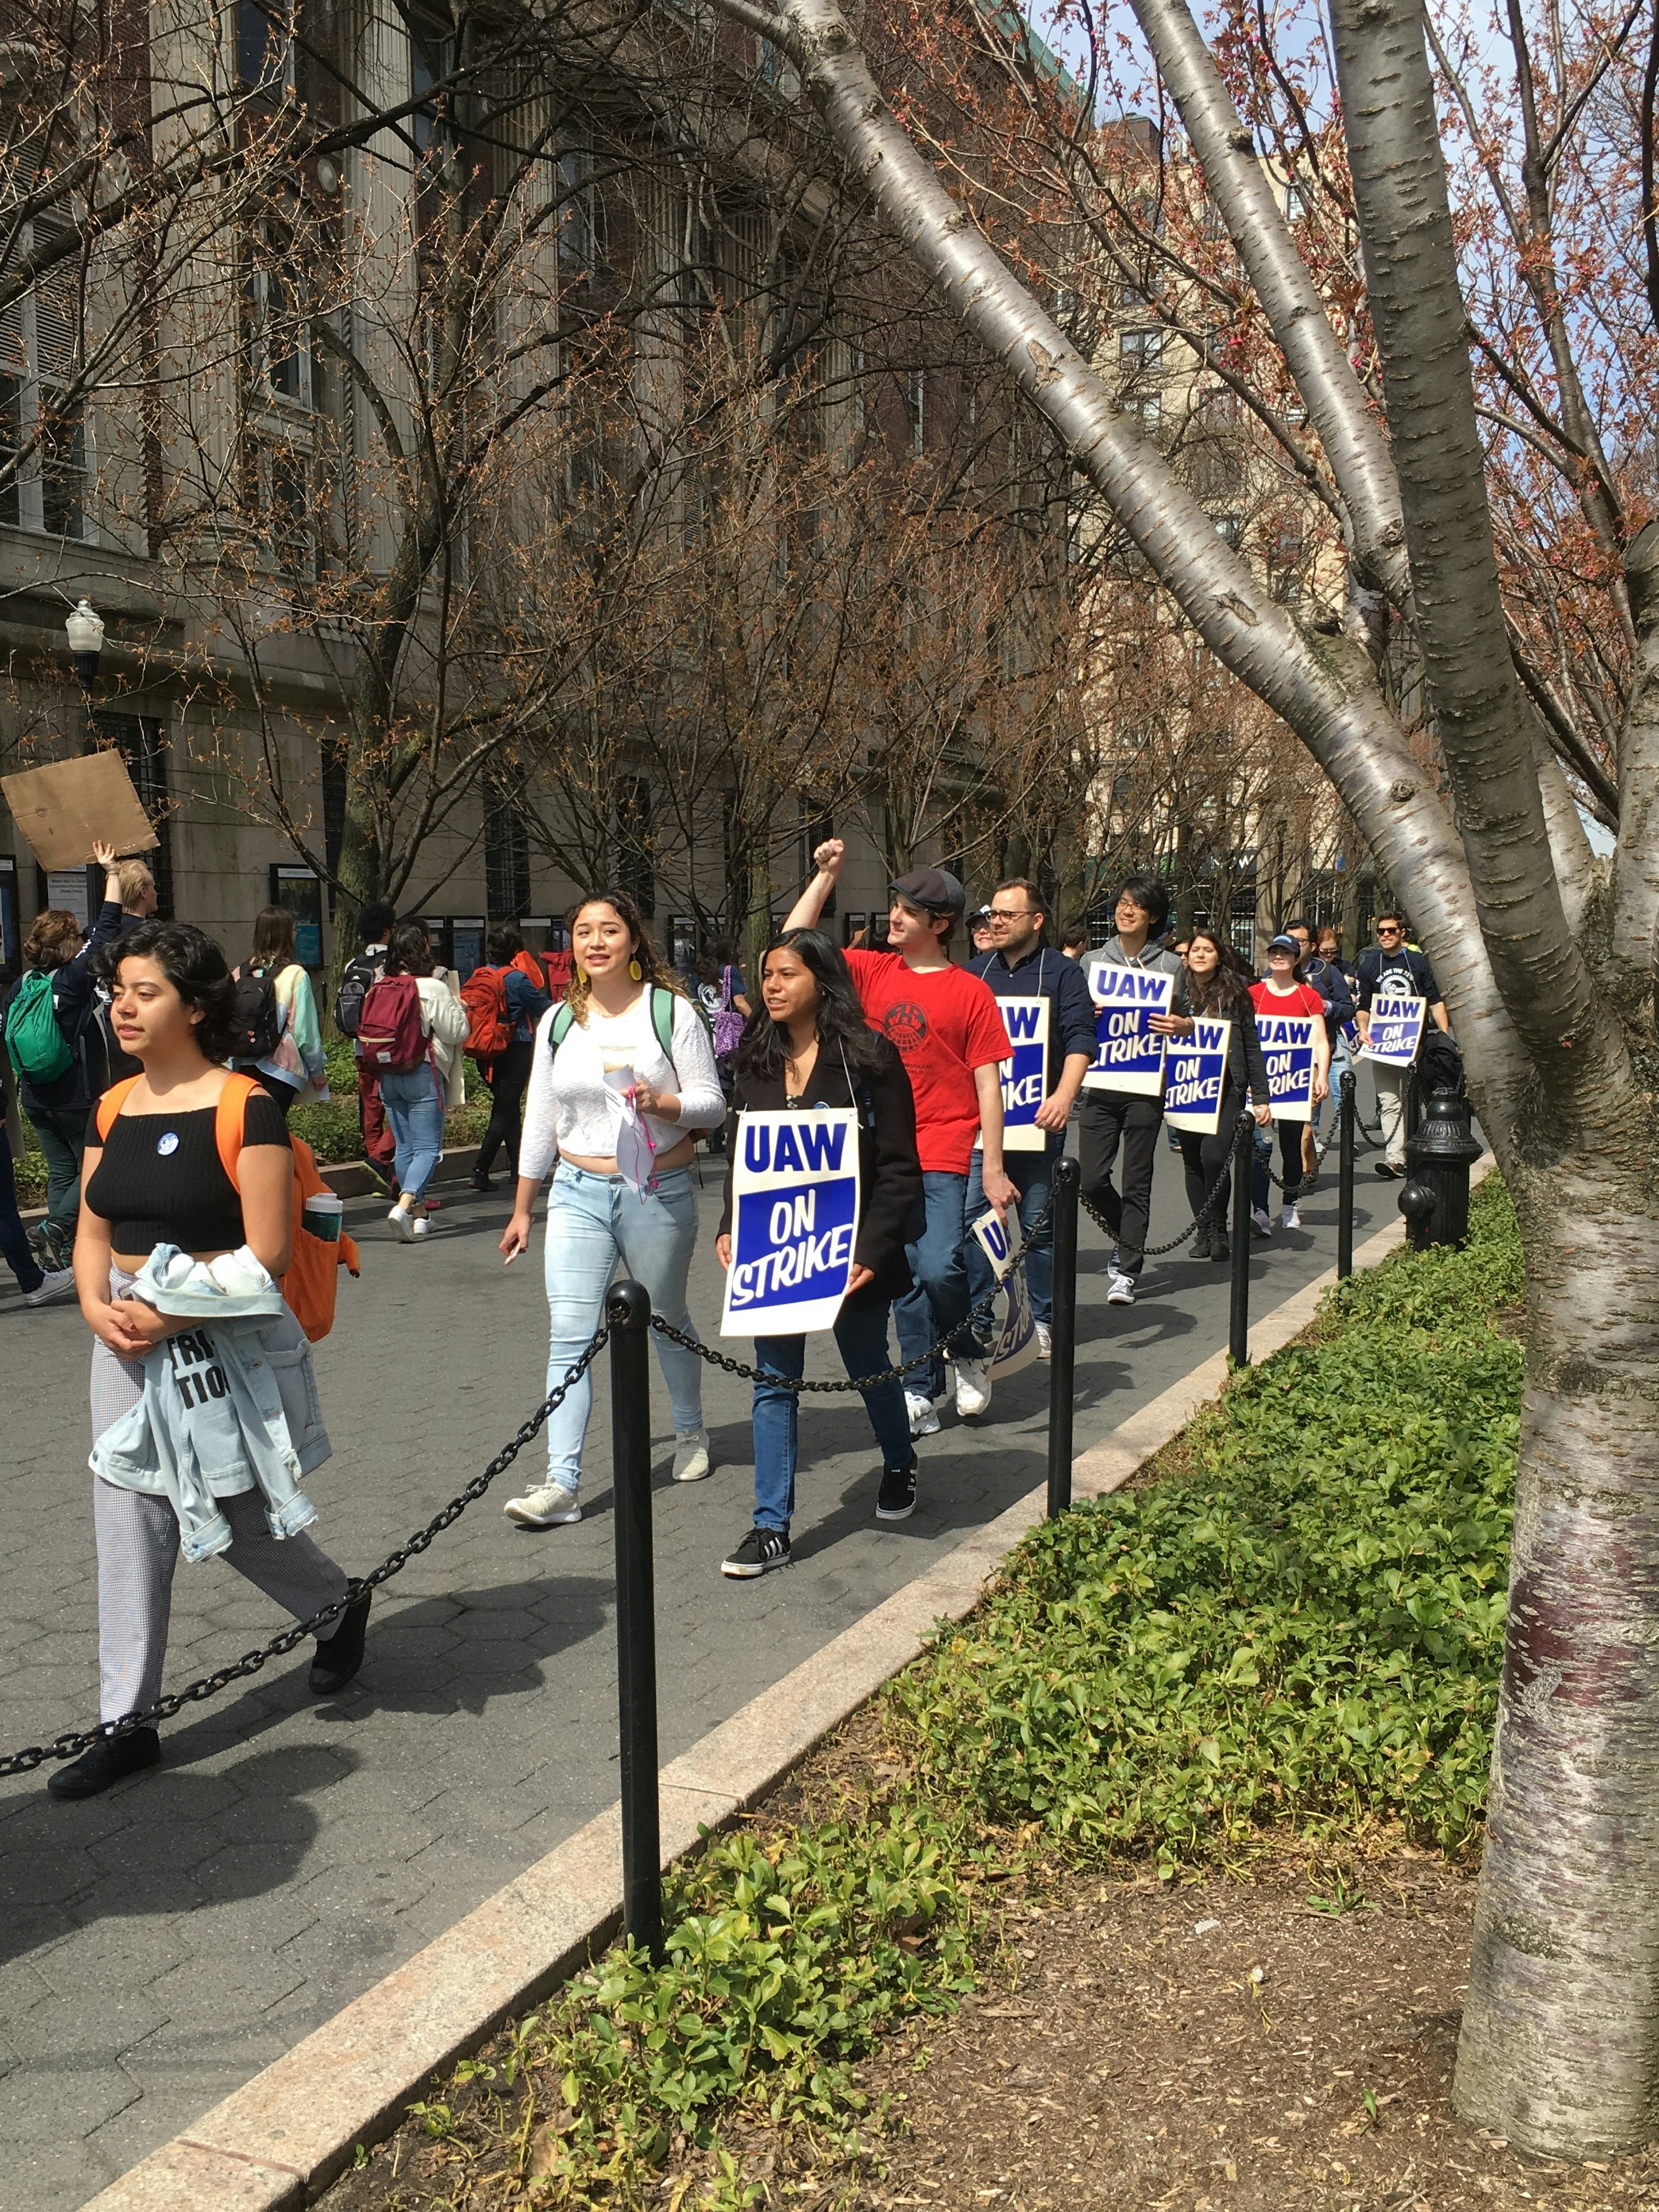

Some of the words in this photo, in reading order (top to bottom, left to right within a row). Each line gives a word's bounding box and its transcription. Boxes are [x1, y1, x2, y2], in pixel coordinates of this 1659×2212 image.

[1097, 969, 1167, 1002] UAW
[1376, 999, 1420, 1019] UAW
[1108, 1009, 1140, 1037] ON
[1257, 1020, 1312, 1045] UAW
[1382, 1024, 1404, 1042] ON
[1175, 1057, 1201, 1082] ON
[1266, 1051, 1292, 1076] ON
[745, 1123, 848, 1173] UAW
[770, 1189, 816, 1244] ON
[732, 1223, 853, 1306] STRIKE
